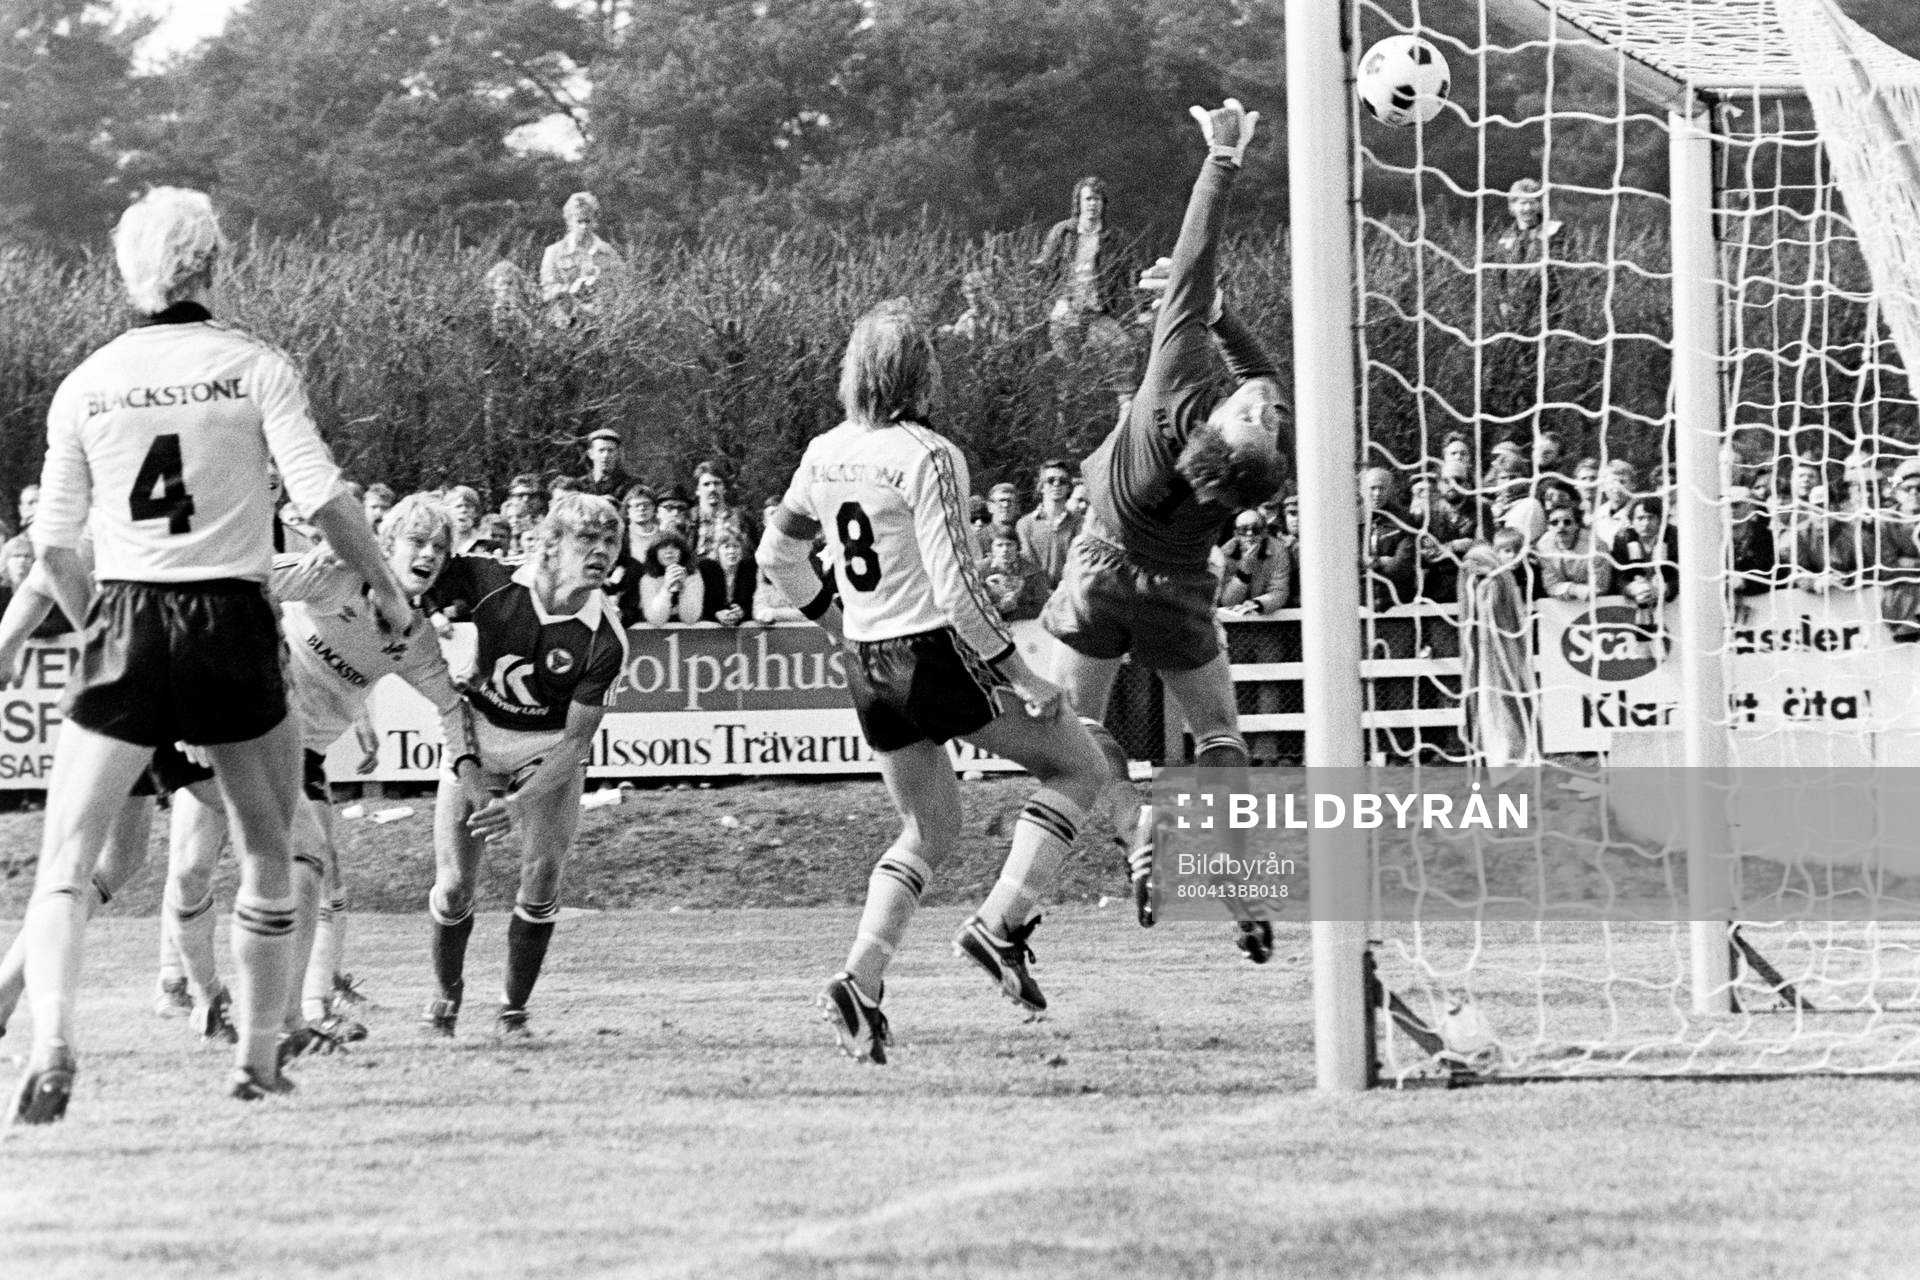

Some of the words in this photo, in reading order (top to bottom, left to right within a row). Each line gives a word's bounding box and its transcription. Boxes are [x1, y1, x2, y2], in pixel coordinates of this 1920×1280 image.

[86, 377, 249, 418] BLACKSTONE
[129, 433, 195, 535] 4
[836, 501, 881, 592] 8
[616, 631, 848, 710] olpahus
[1734, 614, 1860, 655] assler
